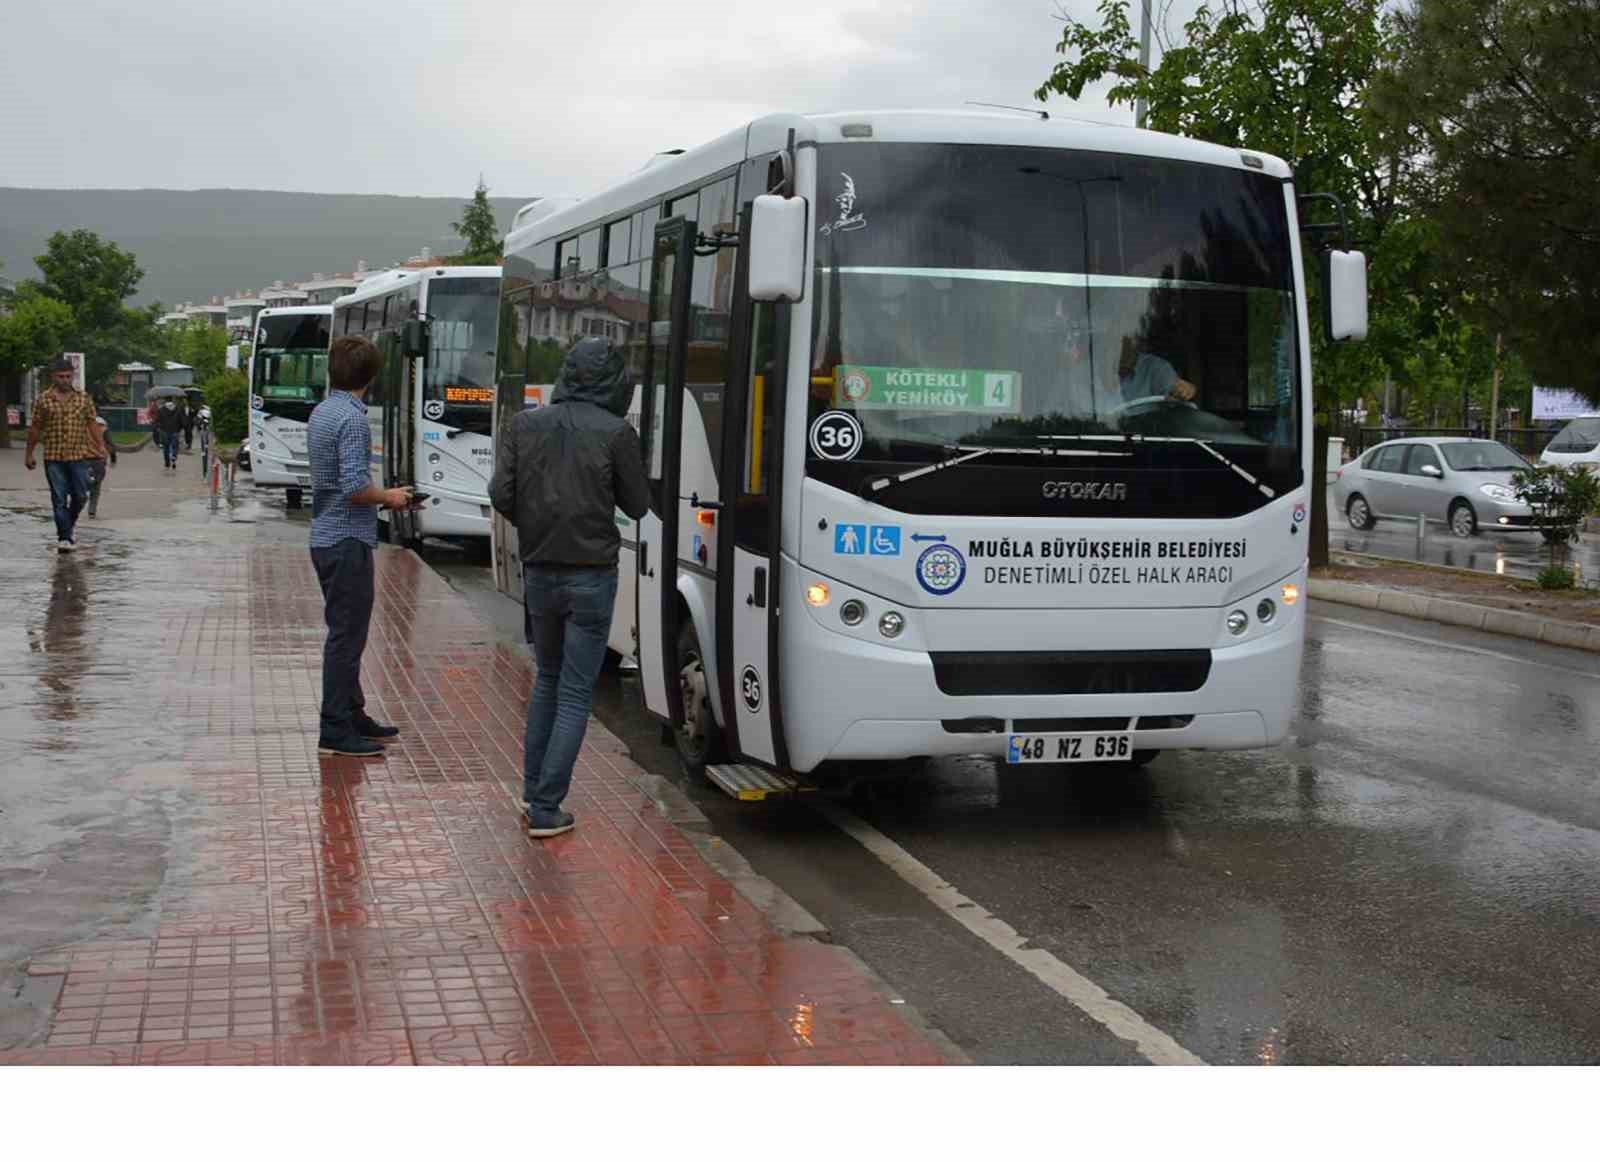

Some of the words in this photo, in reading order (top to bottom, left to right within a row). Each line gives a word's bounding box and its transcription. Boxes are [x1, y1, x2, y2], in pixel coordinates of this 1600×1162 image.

[886, 371, 967, 387] KÖTEKLİ
[884, 389, 969, 405] YENİKÖY
[992, 380, 1006, 404] 4
[820, 426, 853, 447] 36
[1042, 481, 1127, 500] OTOKAR
[969, 537, 1033, 558] MUĞLA
[1041, 537, 1151, 559] BÜYÜKŞEHİR
[1158, 538, 1246, 558] BELEDİYESİ
[984, 563, 1083, 584] DENETİMLİ
[1089, 563, 1131, 584] ÖZEL
[1137, 567, 1180, 584] HALK
[1186, 566, 1233, 583] ARACI
[744, 678, 760, 701] 36
[1022, 738, 1045, 759] 48
[1057, 738, 1082, 759] NZ
[1094, 736, 1129, 757] 636
